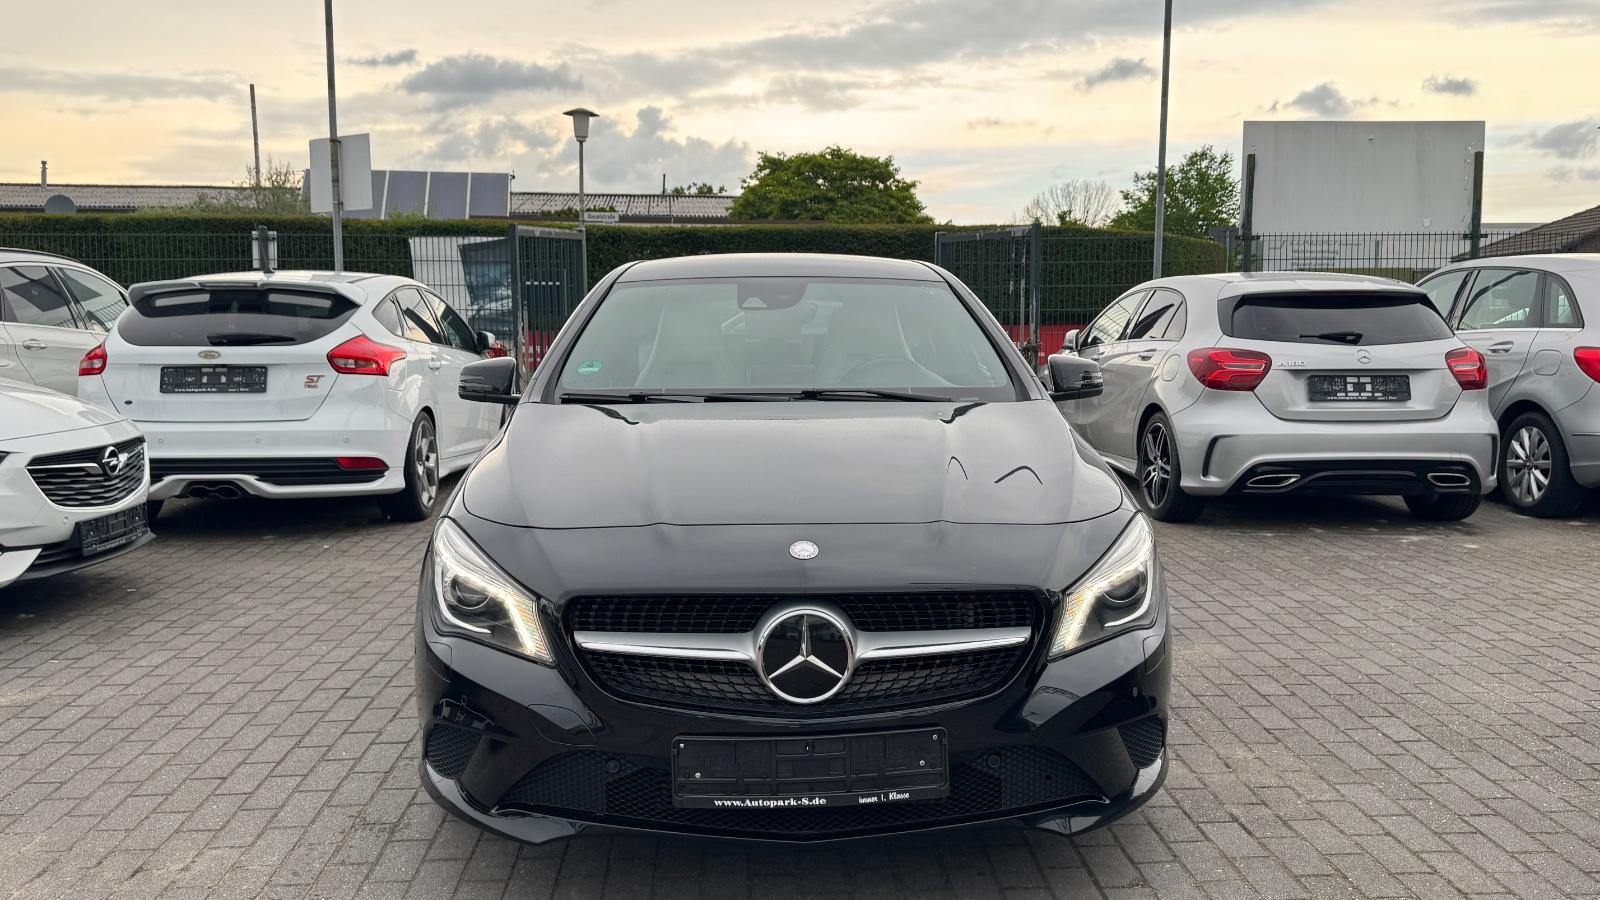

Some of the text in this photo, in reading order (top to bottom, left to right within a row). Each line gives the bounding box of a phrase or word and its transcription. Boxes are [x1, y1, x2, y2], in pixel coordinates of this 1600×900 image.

[304, 375, 325, 384] ST
[714, 797, 826, 808] www.Autopark-S.de
[889, 792, 910, 801] Klasse
